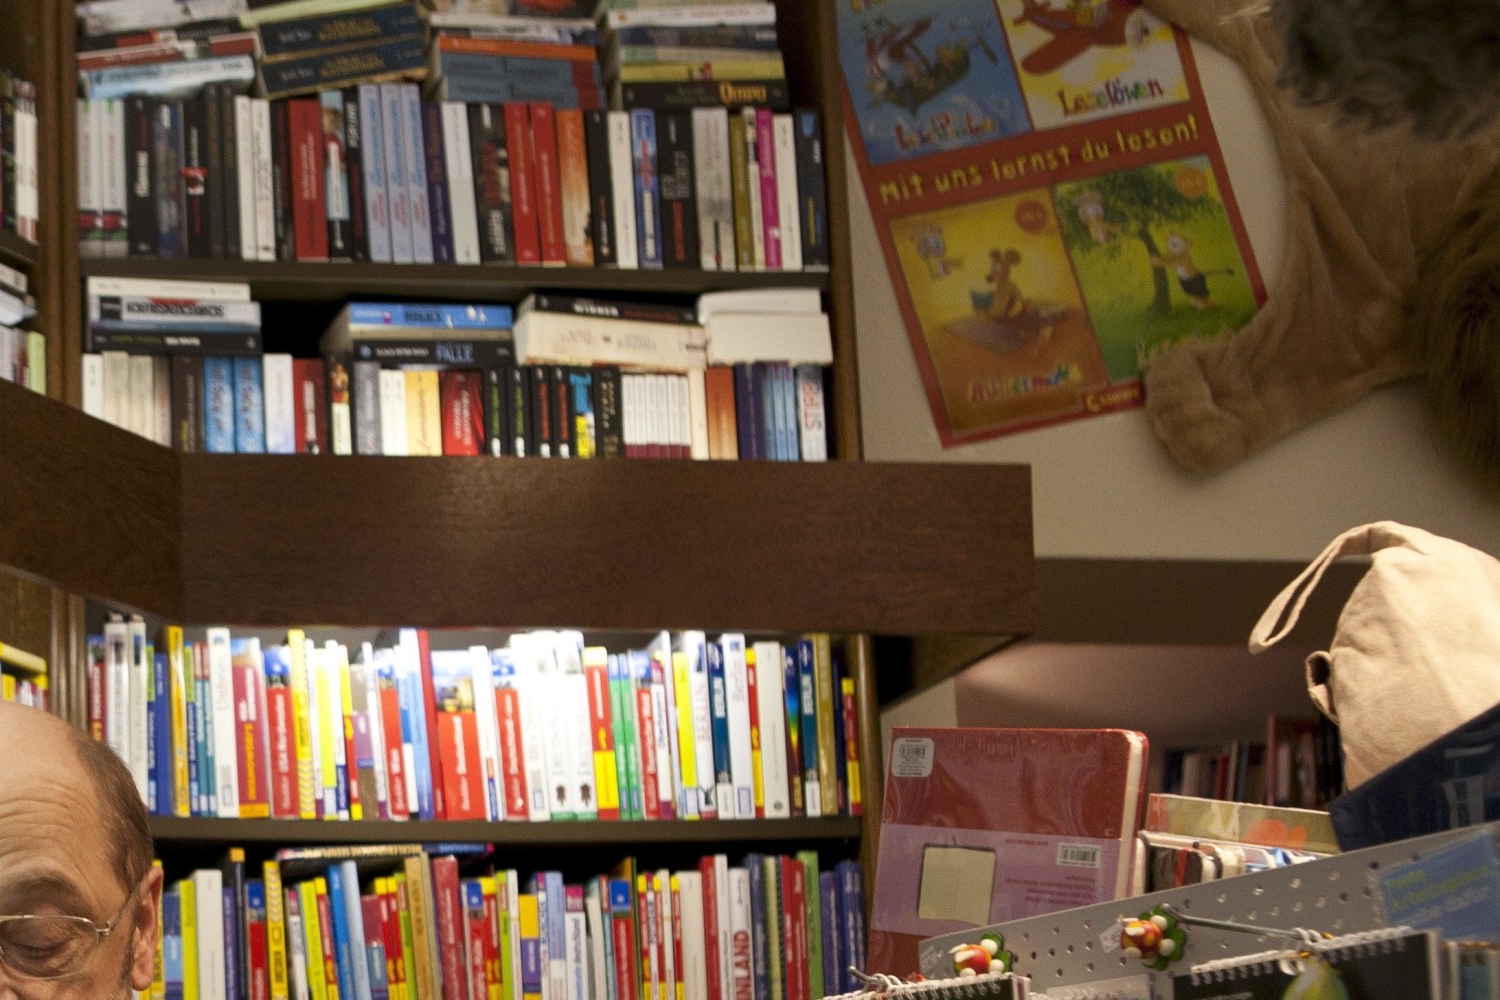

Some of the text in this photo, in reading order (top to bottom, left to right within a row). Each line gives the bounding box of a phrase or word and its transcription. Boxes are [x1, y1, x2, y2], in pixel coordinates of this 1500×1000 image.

[1060, 78, 1164, 118] Leselöwen
[879, 113, 1200, 205] Mit uns lernst du lesen!
[802, 675, 813, 715] BERLIN
